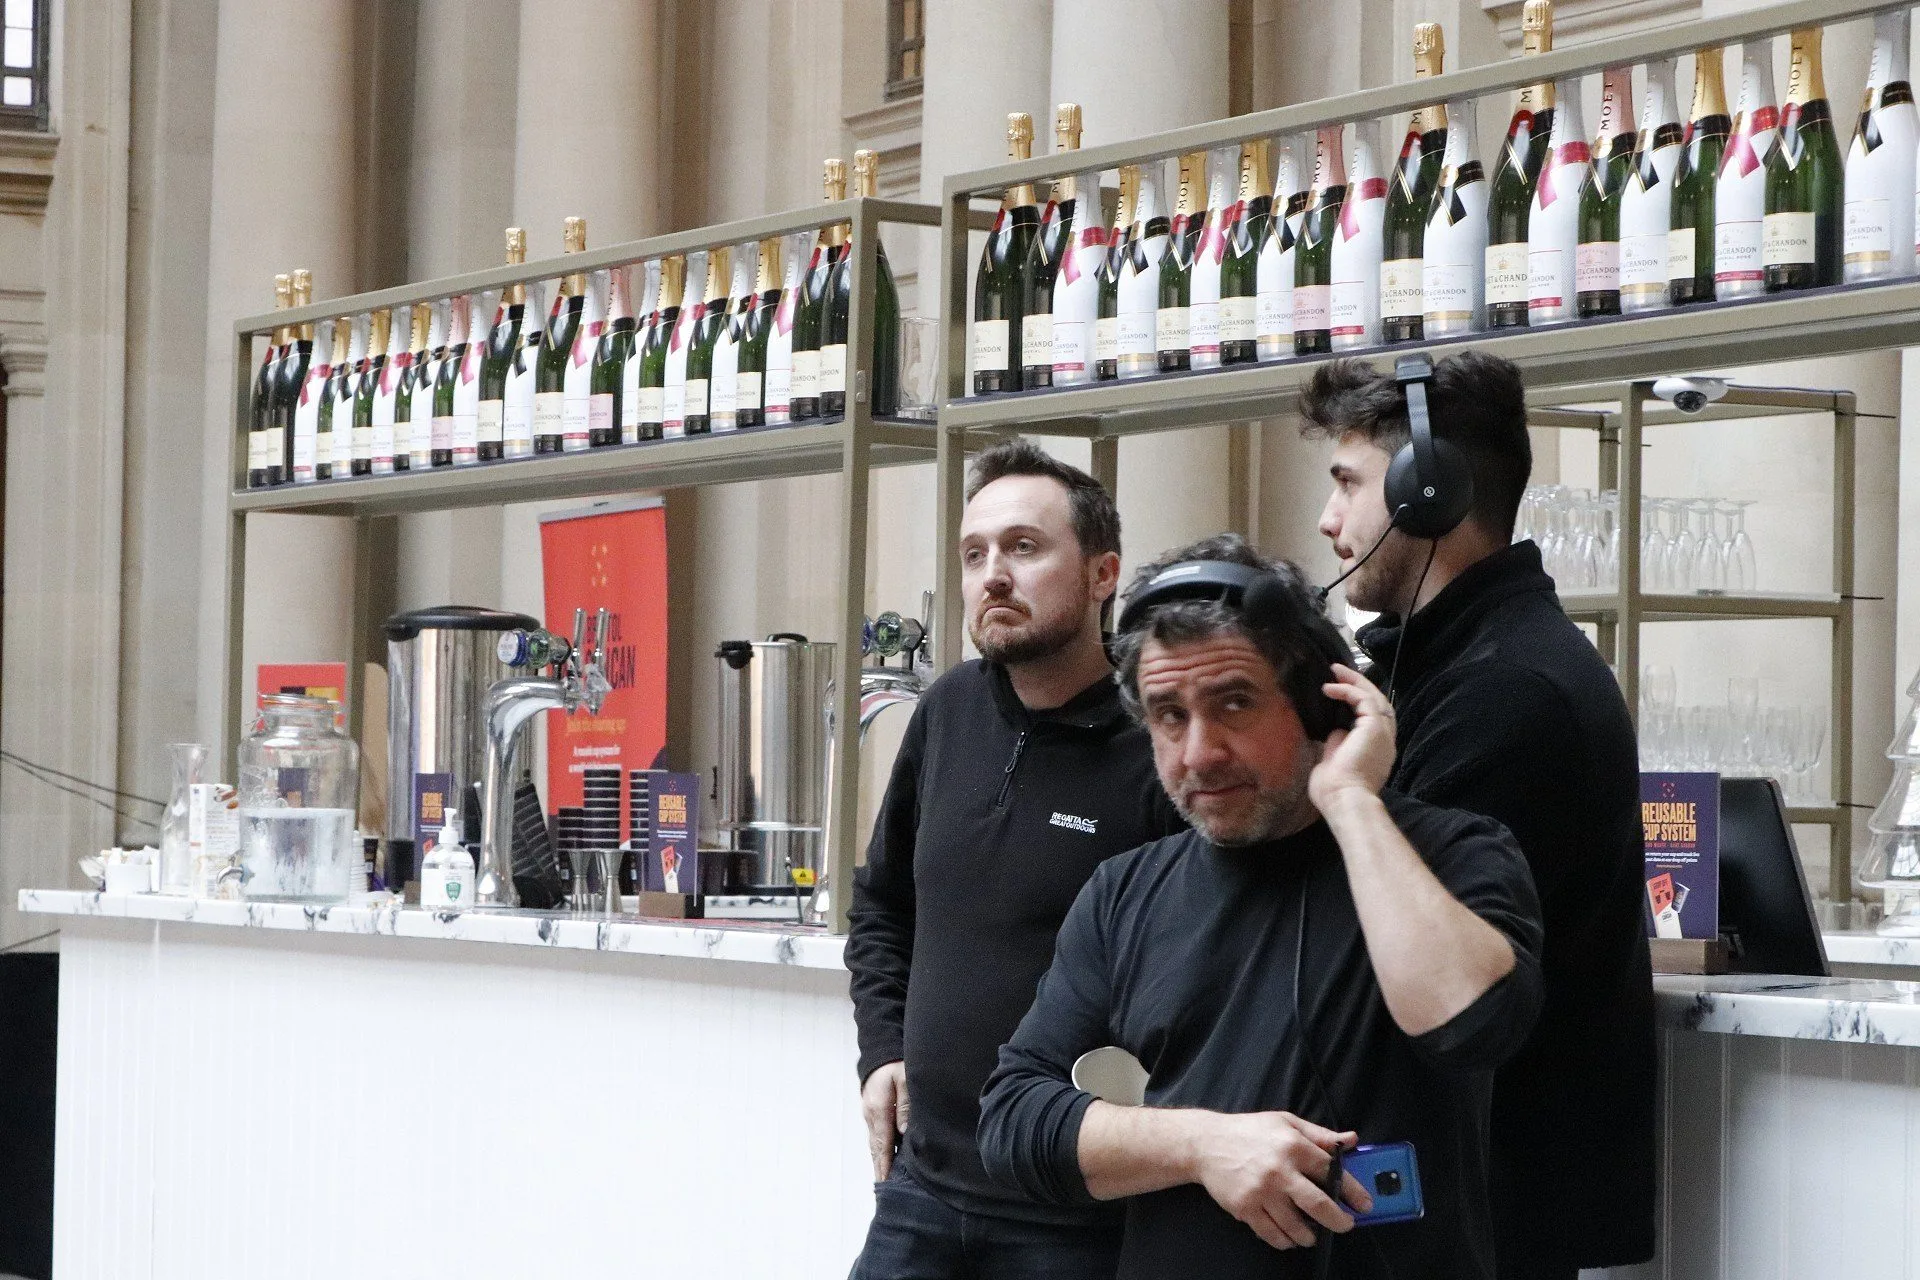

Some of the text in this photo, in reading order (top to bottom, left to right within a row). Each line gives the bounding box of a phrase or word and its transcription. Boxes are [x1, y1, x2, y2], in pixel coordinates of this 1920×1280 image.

[1498, 274, 1528, 282] CHAND
[1051, 811, 1081, 825] REGATTA
[1641, 802, 1696, 823] REUSABLE
[1661, 824, 1696, 841] SYSTEM
